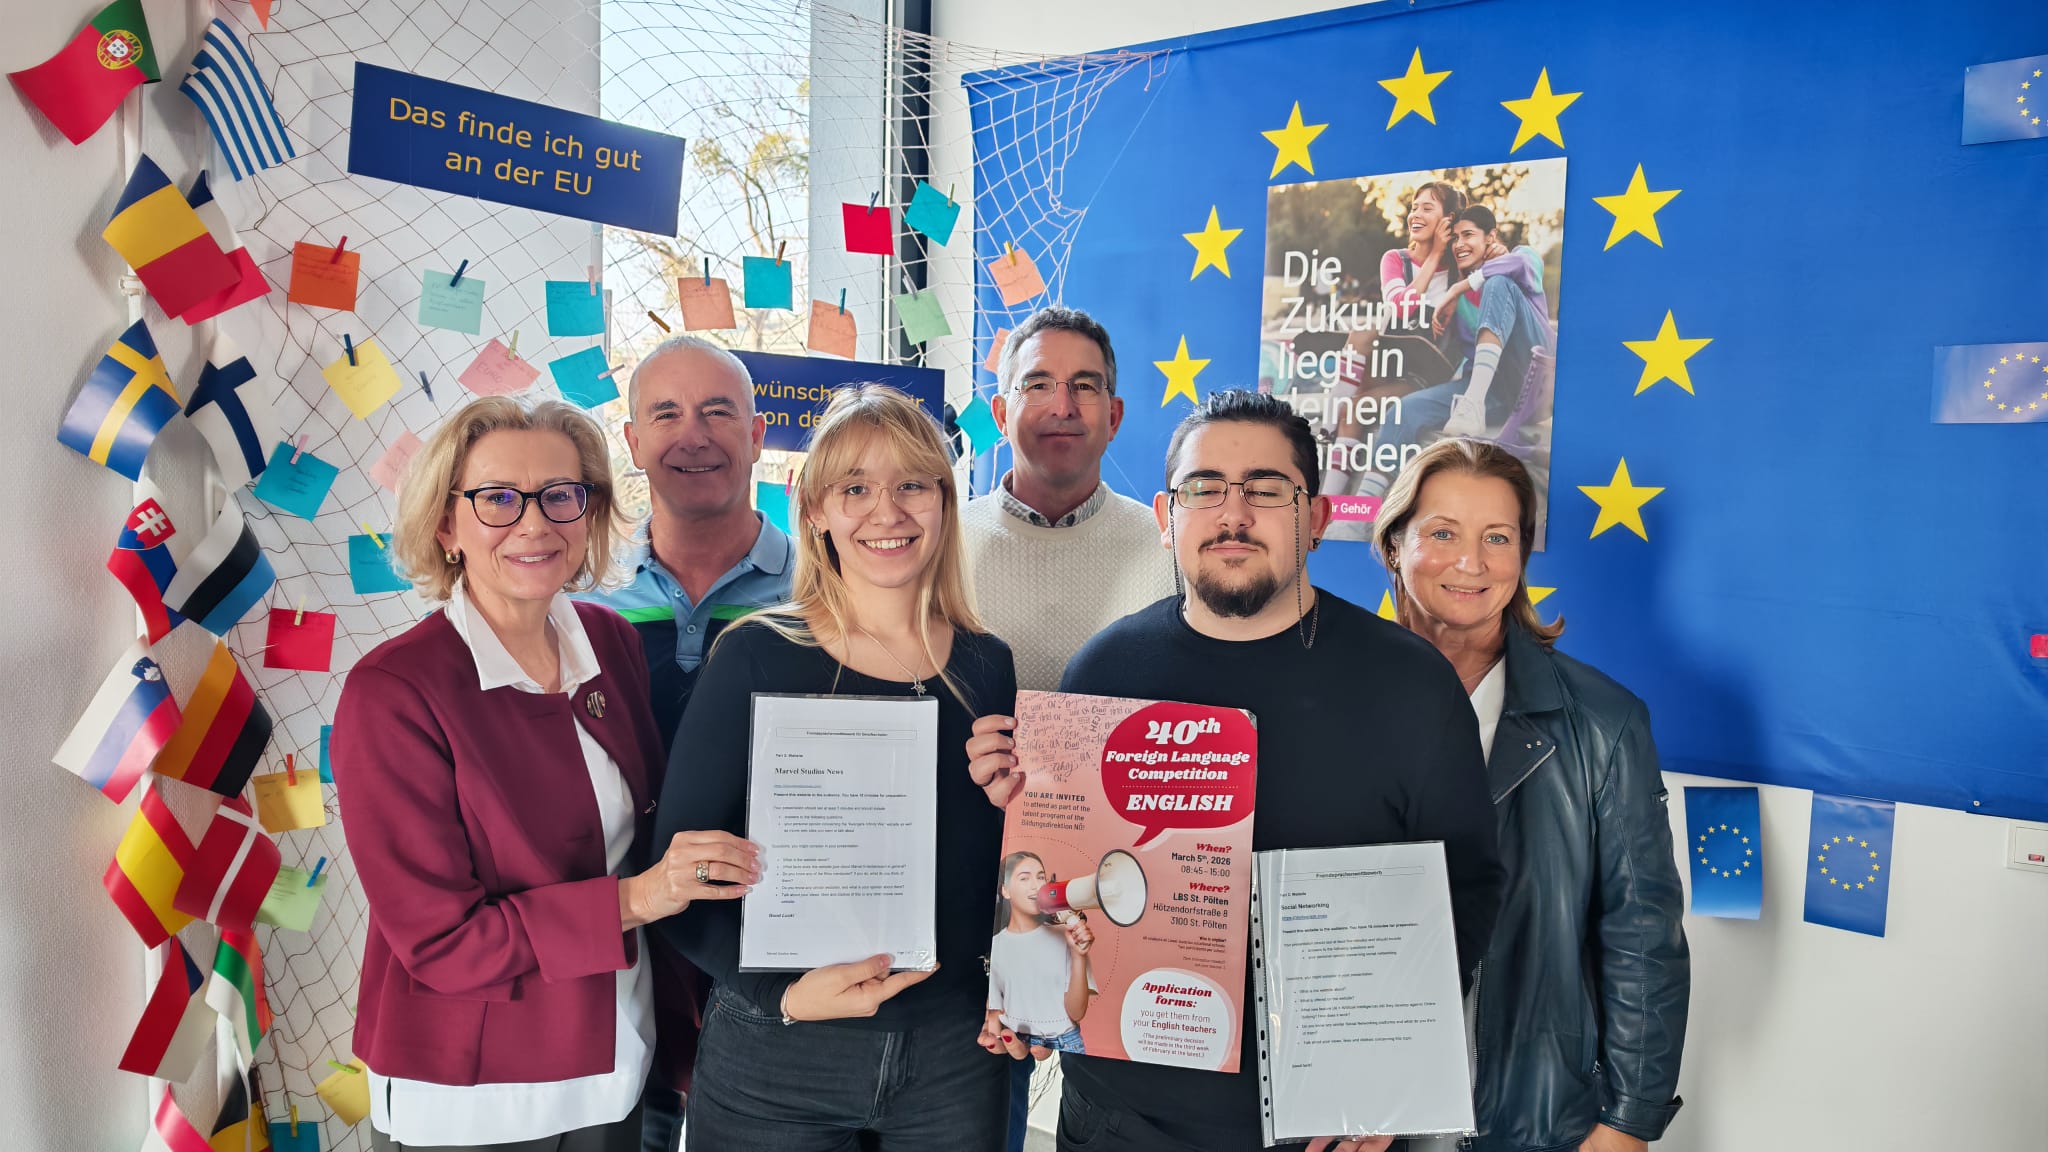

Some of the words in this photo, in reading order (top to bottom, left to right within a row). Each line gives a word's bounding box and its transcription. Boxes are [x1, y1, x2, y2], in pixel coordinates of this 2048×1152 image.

[389, 97, 446, 129] Das
[458, 111, 532, 148] finde
[543, 131, 583, 159] ich
[595, 146, 642, 172] gut
[445, 151, 481, 175] an
[494, 158, 544, 186] der
[554, 170, 592, 195] EU
[1283, 249, 1342, 287] Die
[1280, 288, 1431, 334] Zukunft
[1278, 341, 1358, 388] liegt
[1371, 340, 1404, 378] in
[752, 380, 832, 402] wünsch
[764, 411, 789, 426] on
[798, 410, 823, 428] de
[1340, 502, 1372, 514] Gehör
[1145, 717, 1221, 745] 40th
[1105, 750, 1168, 765] Foreign
[1171, 751, 1250, 766] Language
[775, 767, 799, 775] Marvel
[1128, 768, 1228, 782] Competition
[1056, 793, 1085, 801] INVITED
[1126, 794, 1234, 811] ENGLISH
[1040, 812, 1065, 820] program
[1196, 843, 1232, 853] When?
[1171, 852, 1195, 862] March
[1211, 856, 1231, 865] 2026
[1181, 865, 1203, 875] 08:45
[1210, 868, 1230, 877] 15:00
[1189, 882, 1230, 893] Where?
[1173, 892, 1188, 902] LBS
[1190, 894, 1201, 903] St.
[1203, 895, 1229, 905] Pölten
[1153, 902, 1221, 917] Hötzendorfstraße
[1223, 909, 1228, 917] 8
[1170, 916, 1188, 926] 3100
[1190, 918, 1201, 927] St.
[1202, 919, 1227, 930] Pölten
[1142, 982, 1212, 997] Application
[1155, 995, 1197, 1008] forms:
[1140, 1009, 1153, 1017] you
[1156, 1010, 1168, 1019] get
[1170, 1011, 1190, 1020] them
[1192, 1013, 1211, 1023] from
[1133, 1019, 1149, 1028] your
[1151, 1019, 1180, 1031] English
[1181, 1023, 1217, 1034] teachers
